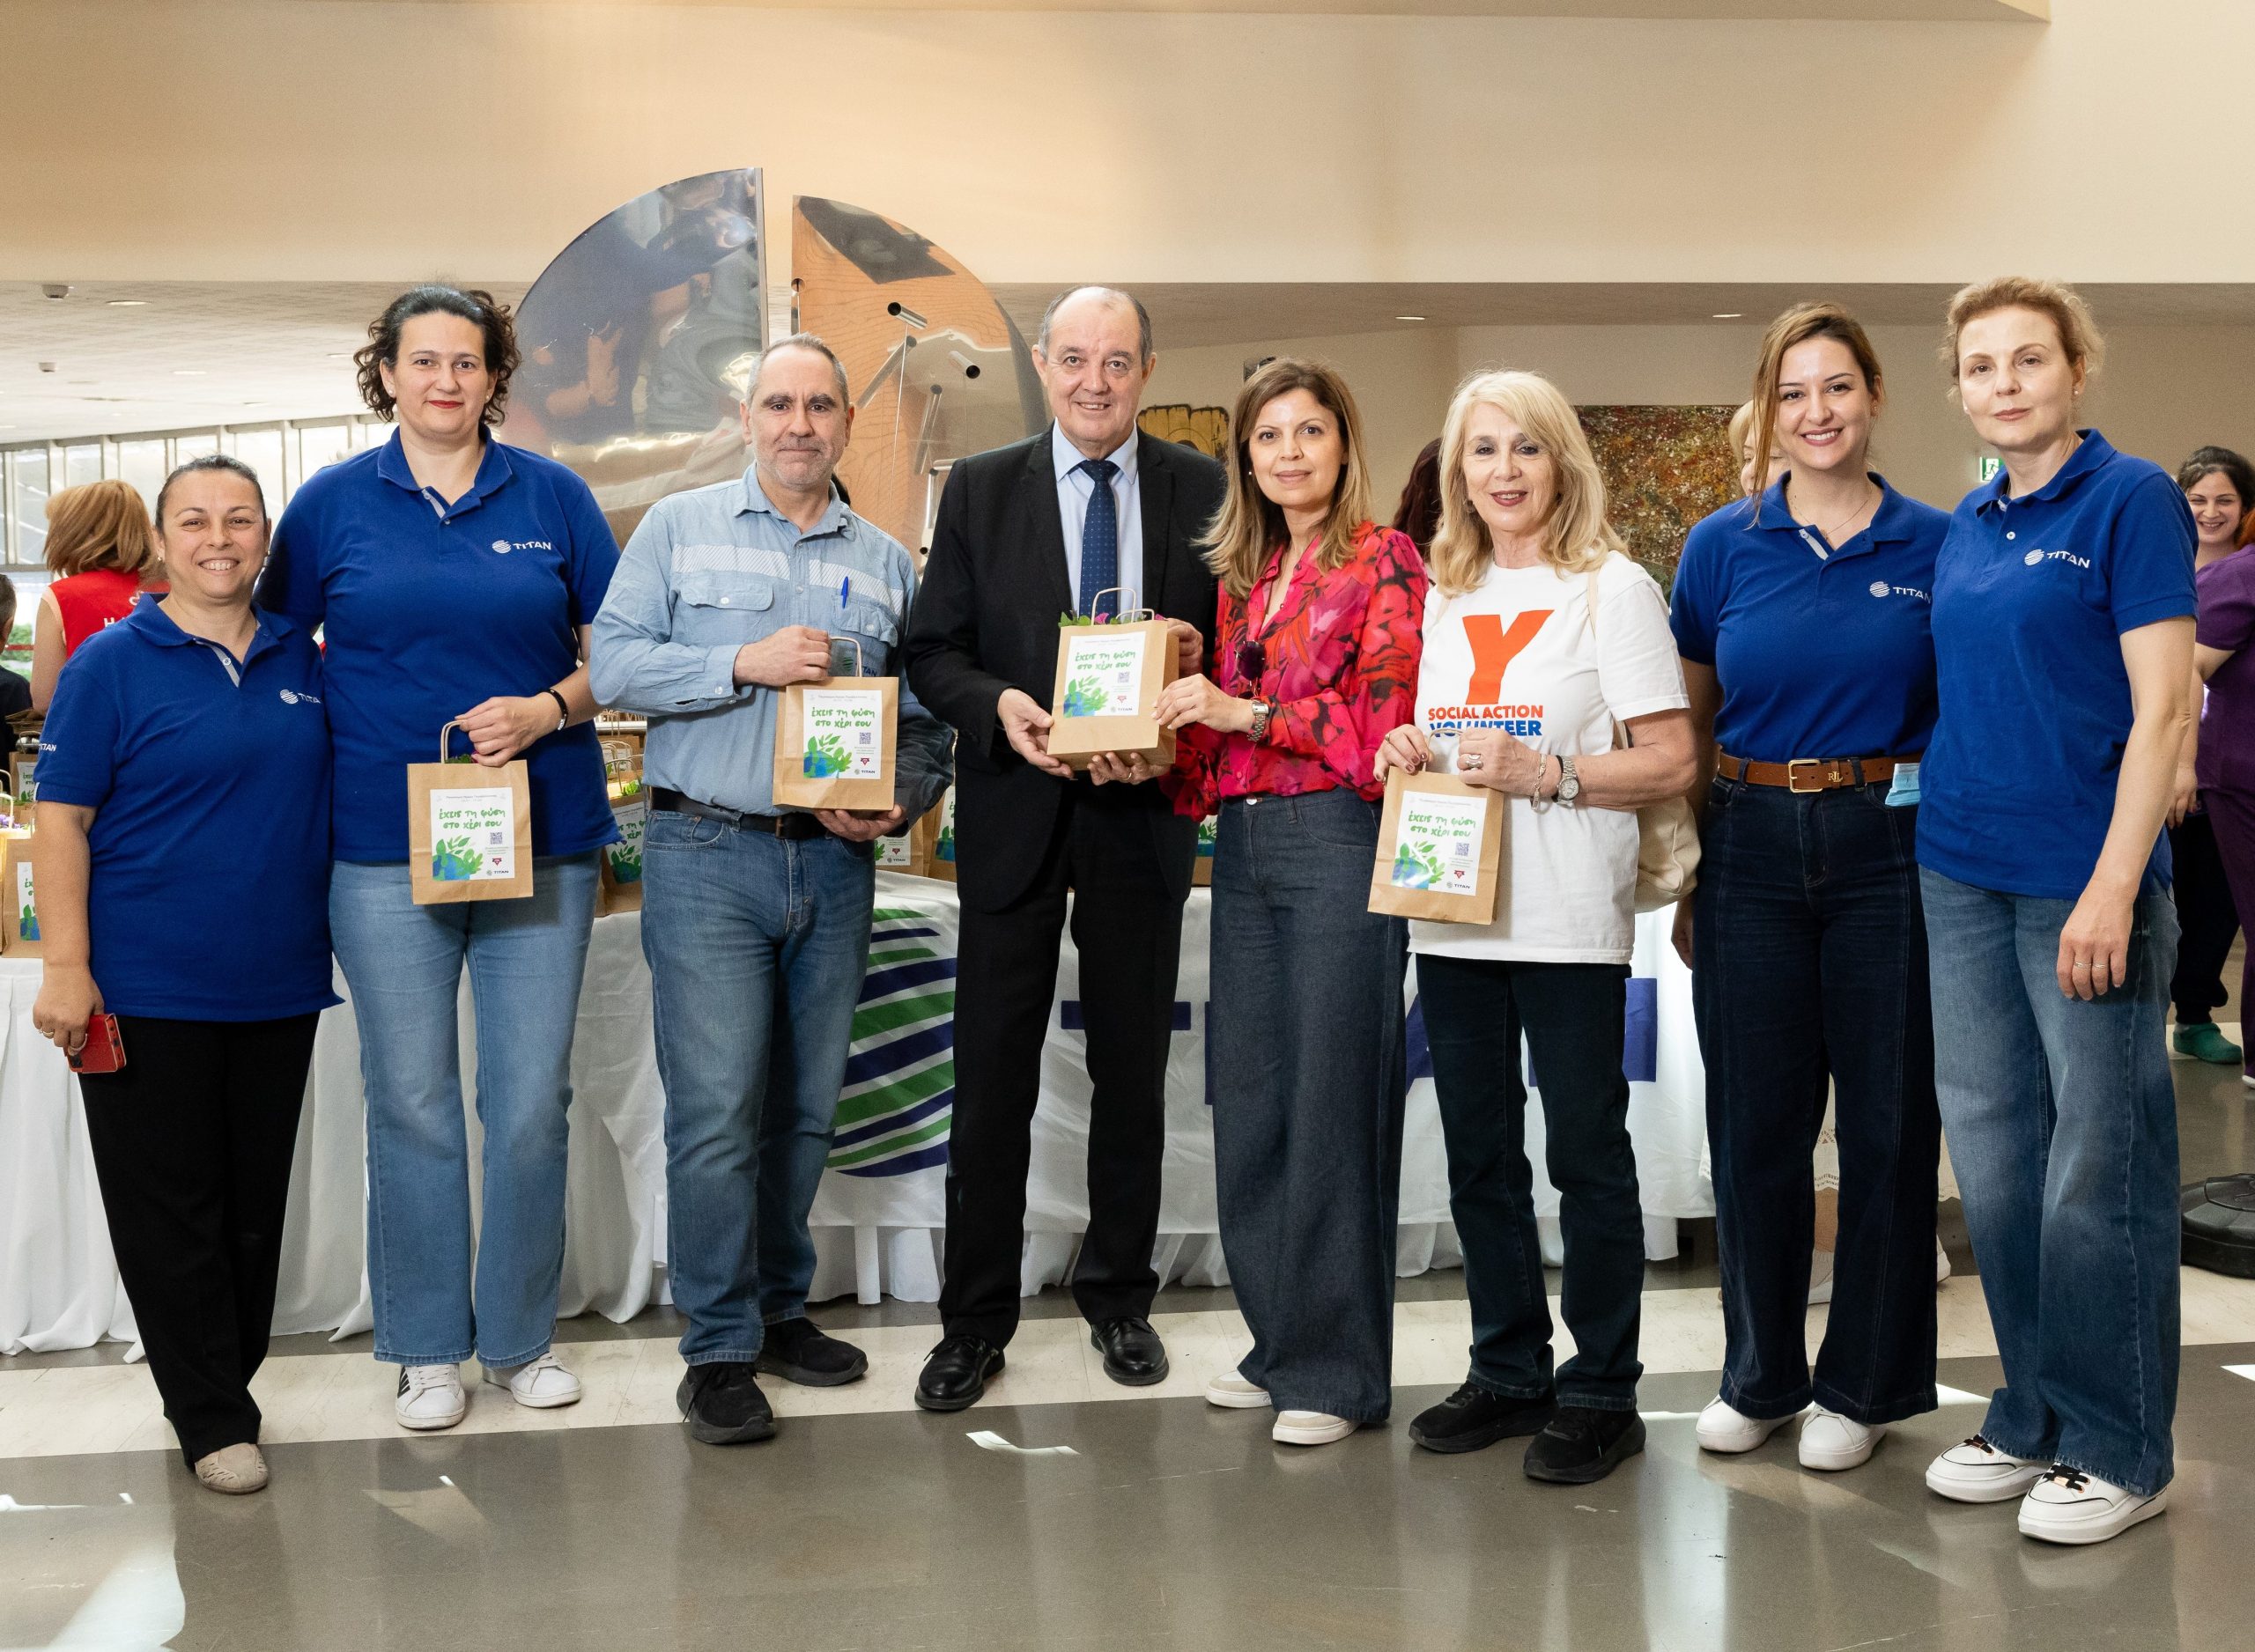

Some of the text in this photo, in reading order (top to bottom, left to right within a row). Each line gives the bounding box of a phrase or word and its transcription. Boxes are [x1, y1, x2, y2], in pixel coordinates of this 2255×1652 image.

[513, 541, 552, 550] TITAN
[2047, 550, 2090, 569] TITAN
[1892, 586, 1931, 605] TITAN
[1462, 609, 1555, 704] Y
[298, 692, 322, 704] TITA
[836, 709, 848, 718] τη
[1428, 704, 1543, 721] SOCIAL ACTION
[465, 810, 477, 819] τη
